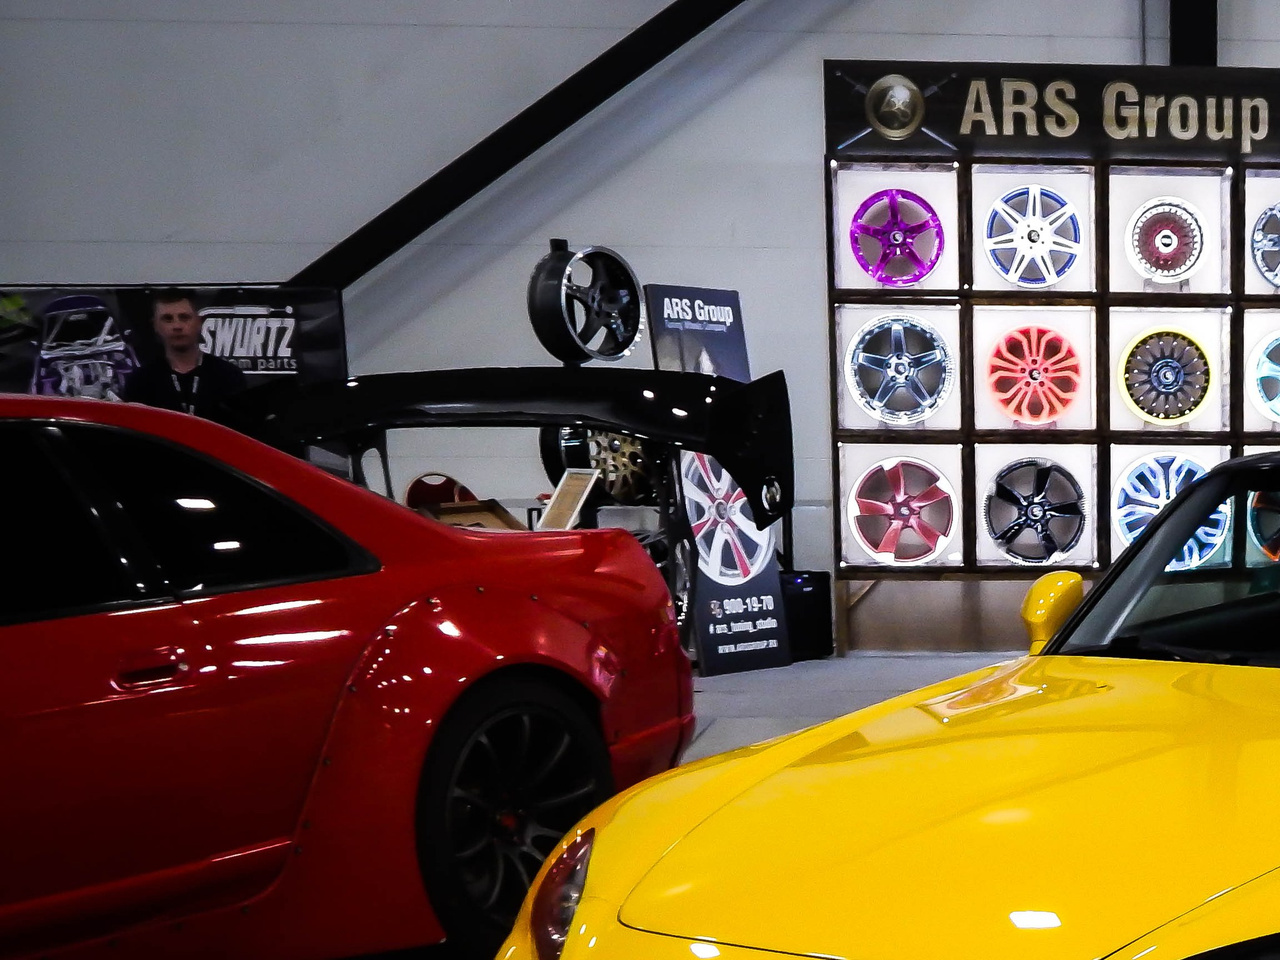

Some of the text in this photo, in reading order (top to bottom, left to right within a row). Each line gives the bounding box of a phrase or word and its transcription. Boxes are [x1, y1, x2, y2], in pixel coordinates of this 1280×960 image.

[959, 77, 1269, 153] ARS Group
[663, 297, 693, 320] ARS
[694, 299, 734, 327] Group
[199, 317, 296, 357] SWURTZ
[257, 358, 298, 371] parts
